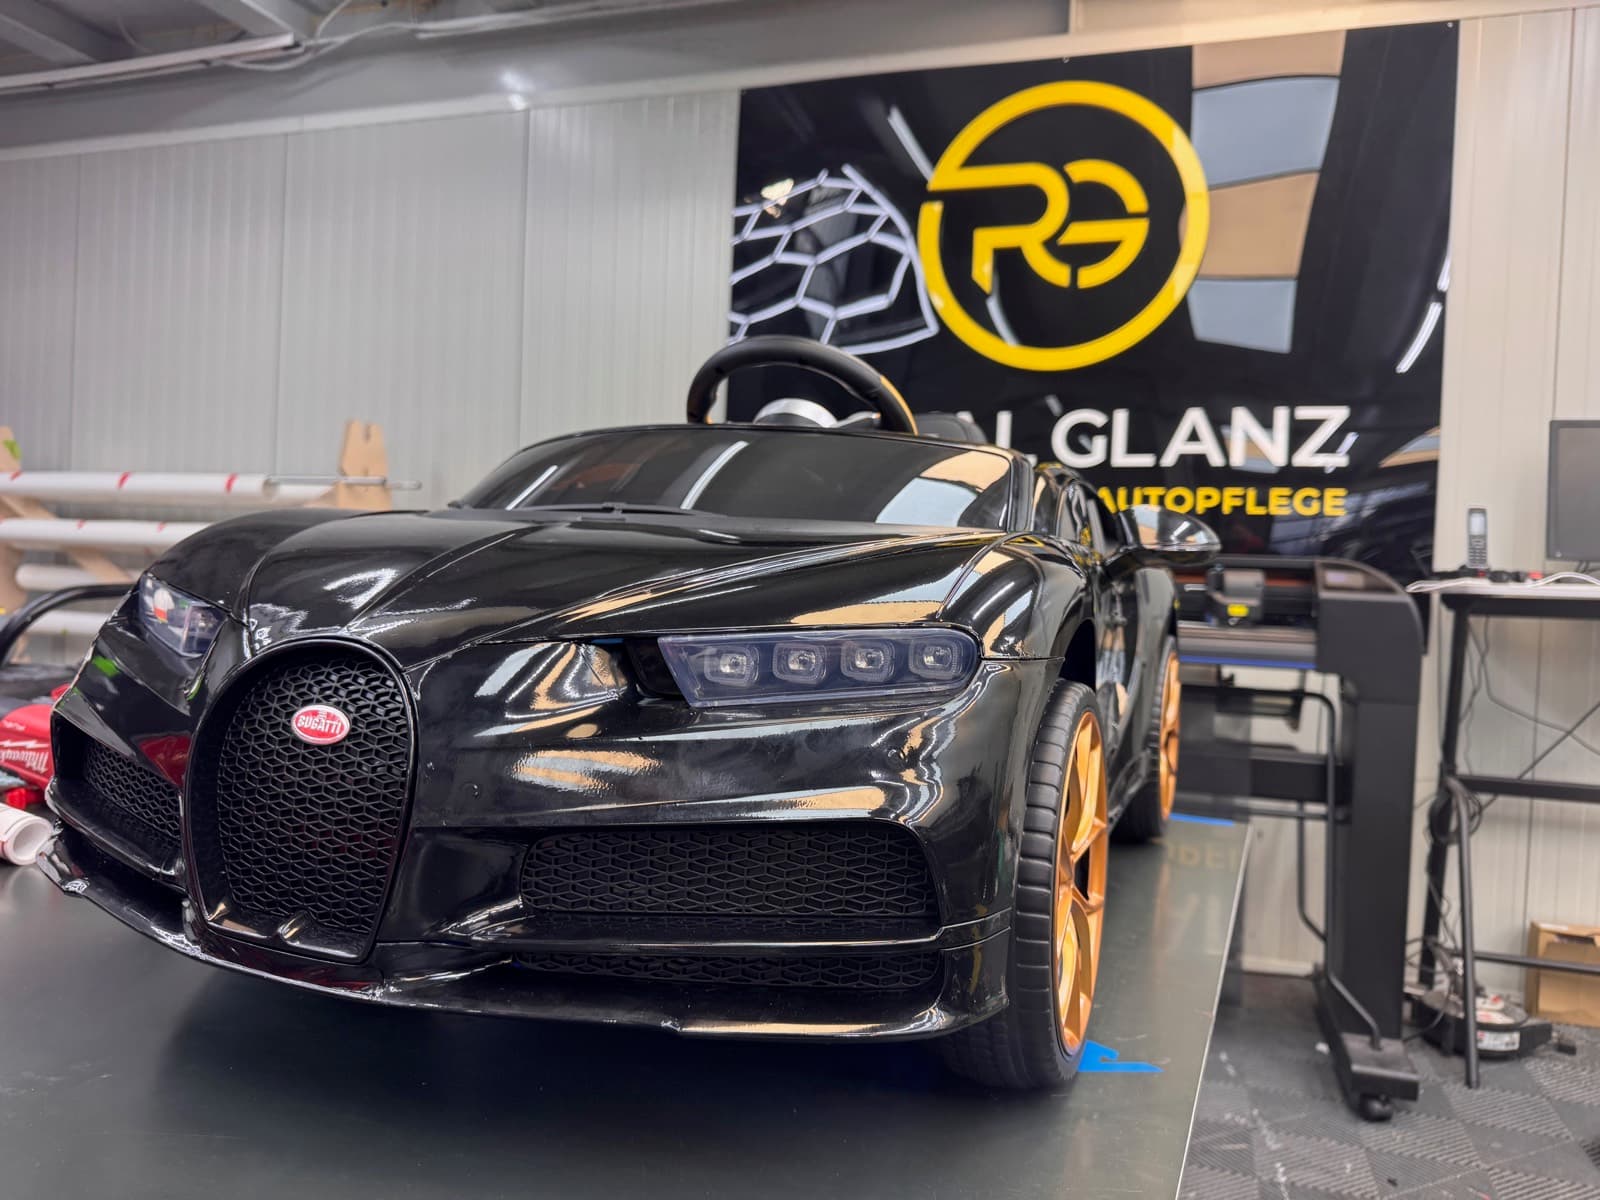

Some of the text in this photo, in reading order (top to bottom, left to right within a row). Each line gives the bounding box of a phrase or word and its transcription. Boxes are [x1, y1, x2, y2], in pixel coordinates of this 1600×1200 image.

[928, 158, 1150, 294] RG
[956, 405, 1351, 469] L GLANZ
[1097, 486, 1348, 516] AUTOPFLEGE
[297, 714, 343, 735] BUGATTI
